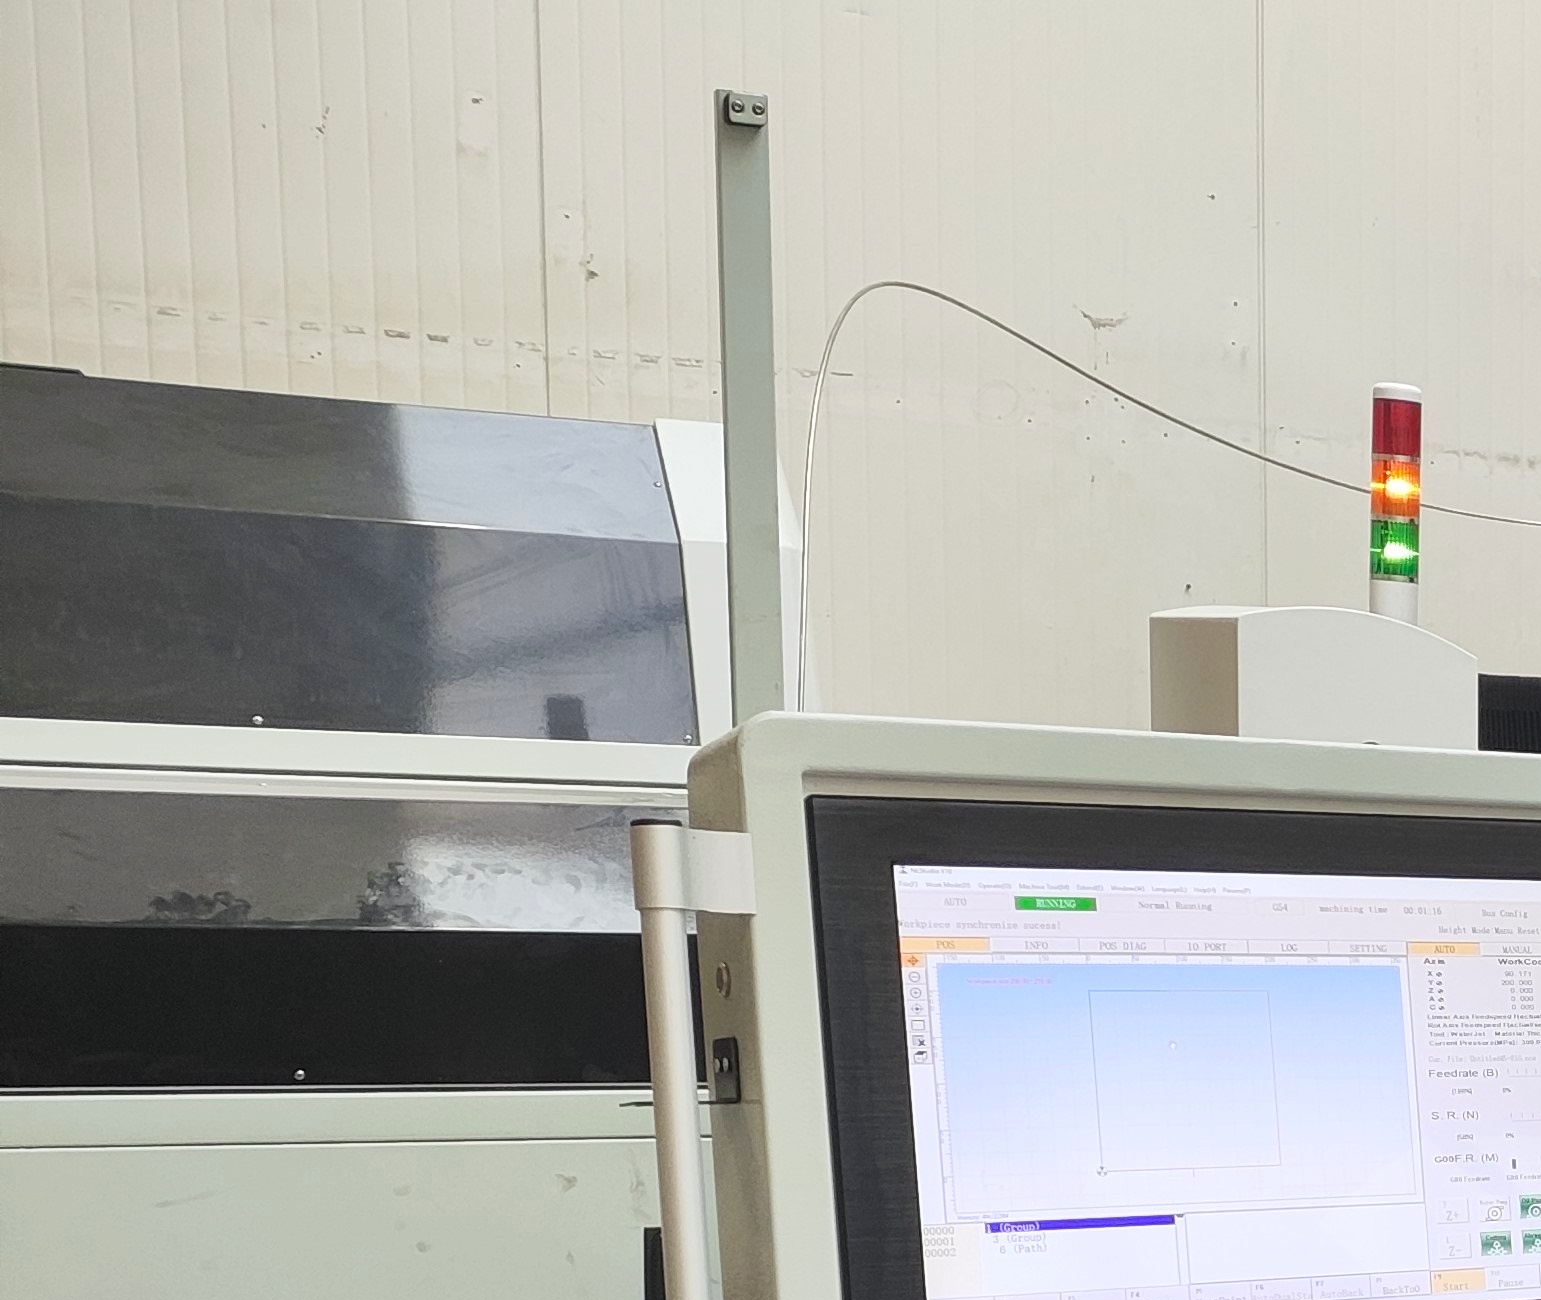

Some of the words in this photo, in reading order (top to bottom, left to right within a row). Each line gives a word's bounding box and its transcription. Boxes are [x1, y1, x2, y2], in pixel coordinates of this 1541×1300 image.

[944, 897, 967, 906] AUTO
[1036, 898, 1077, 909] RUNNING
[1138, 901, 1169, 910] Normal
[1175, 902, 1213, 911] Running
[1272, 903, 1288, 912] G54
[1319, 904, 1364, 914] machining
[1369, 905, 1388, 914] time
[956, 920, 1018, 931] synchronize
[936, 940, 956, 950] POS
[1024, 941, 1049, 950] INFO
[1099, 941, 1118, 951] POS
[1122, 941, 1147, 951] DIAG
[1204, 942, 1227, 951] PORT
[1280, 943, 1298, 952] LOG
[1349, 944, 1388, 953] SETTING
[1434, 945, 1456, 954] AUTO
[1502, 945, 1533, 955] MANUAL
[1428, 1069, 1478, 1078] Feedrate
[1482, 1067, 1499, 1079] (B)
[923, 1226, 955, 1236] 00000
[999, 1221, 1040, 1233] (Group)
[924, 1237, 955, 1247] 00001
[992, 1235, 999, 1244] 3
[1006, 1232, 1047, 1244] (Group)
[925, 1248, 957, 1258] 00002
[999, 1245, 1006, 1255] 6
[1013, 1243, 1047, 1255] (Path)
[1443, 1282, 1469, 1291] Start
[1498, 1279, 1524, 1288] Pause
